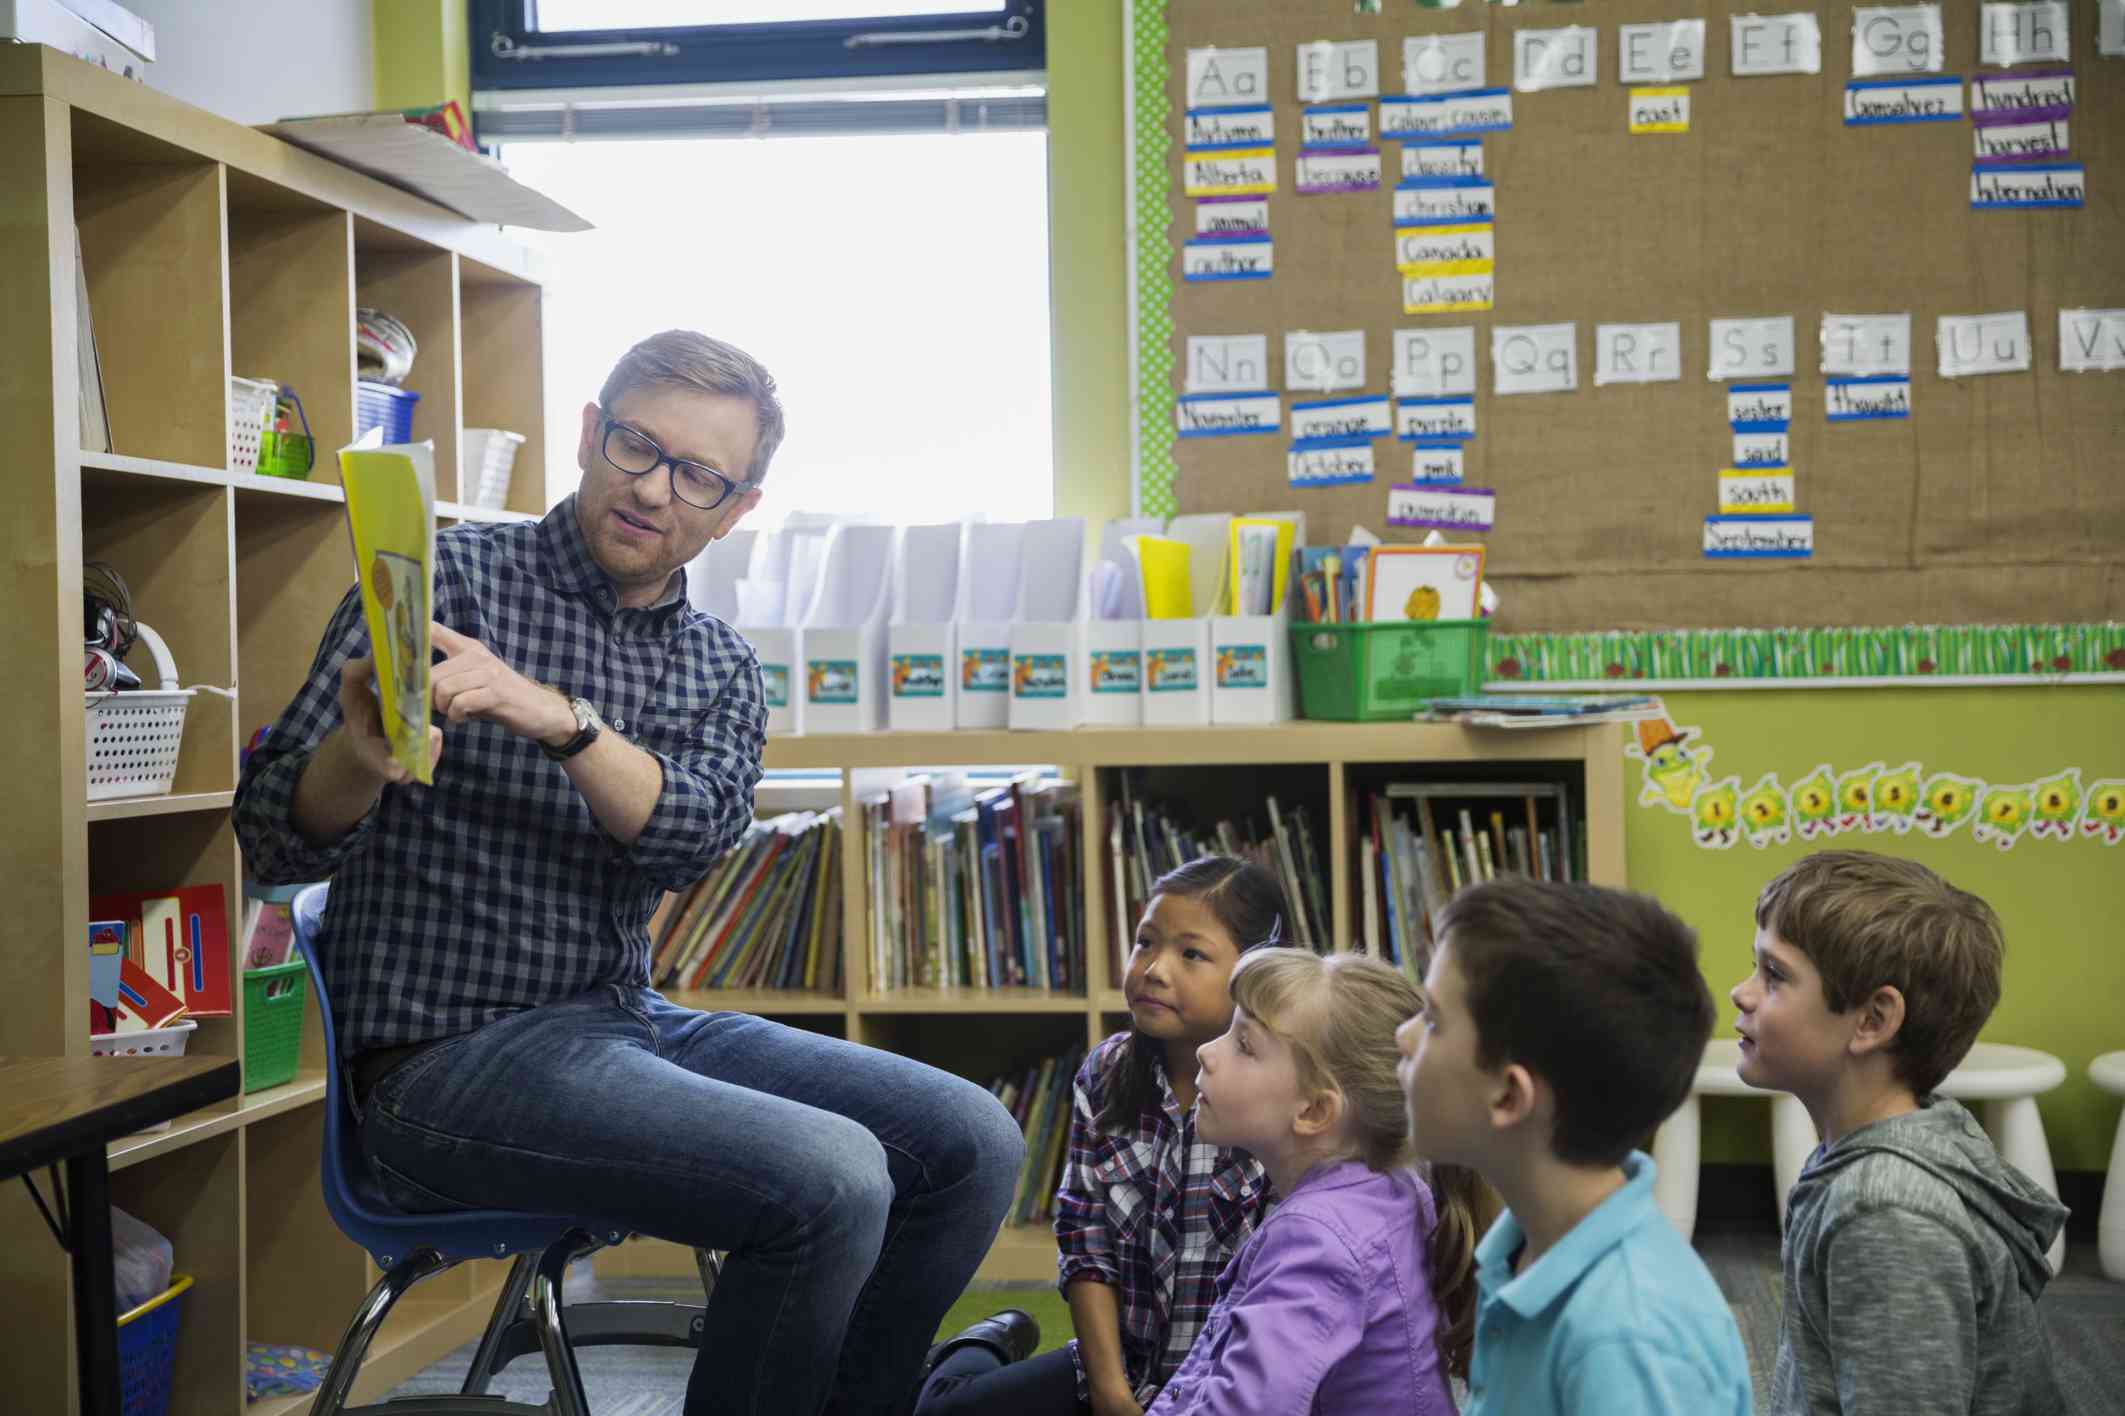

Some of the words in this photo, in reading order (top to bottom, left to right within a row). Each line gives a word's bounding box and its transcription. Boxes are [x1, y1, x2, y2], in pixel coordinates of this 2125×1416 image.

[1741, 25, 1796, 65] Ff
[1863, 16, 1930, 71] Gg
[1991, 11, 2053, 52] Hh
[1415, 45, 1473, 83] Cc
[1629, 32, 1692, 73] Ee
[1198, 57, 1257, 96] Aa
[1979, 79, 2074, 110] hundred
[1636, 99, 1681, 124] east
[1978, 121, 2059, 156] harvest
[1194, 159, 1265, 186] Alberta
[1976, 172, 2083, 203] hibernation
[1205, 208, 1265, 233] animal
[1403, 237, 1483, 262] Canada
[1408, 278, 1493, 304] Calgary
[1503, 334, 1571, 386] Qq
[1612, 333, 1667, 372] Rr
[1724, 327, 1779, 367] Ss
[1839, 322, 1897, 364] Tt
[1950, 322, 2016, 363] Uu
[1197, 343, 1257, 383] Nn
[1407, 336, 1465, 388] Pp
[1407, 409, 1467, 438] purple
[1725, 481, 1788, 505] south
[1705, 519, 1808, 551] September
